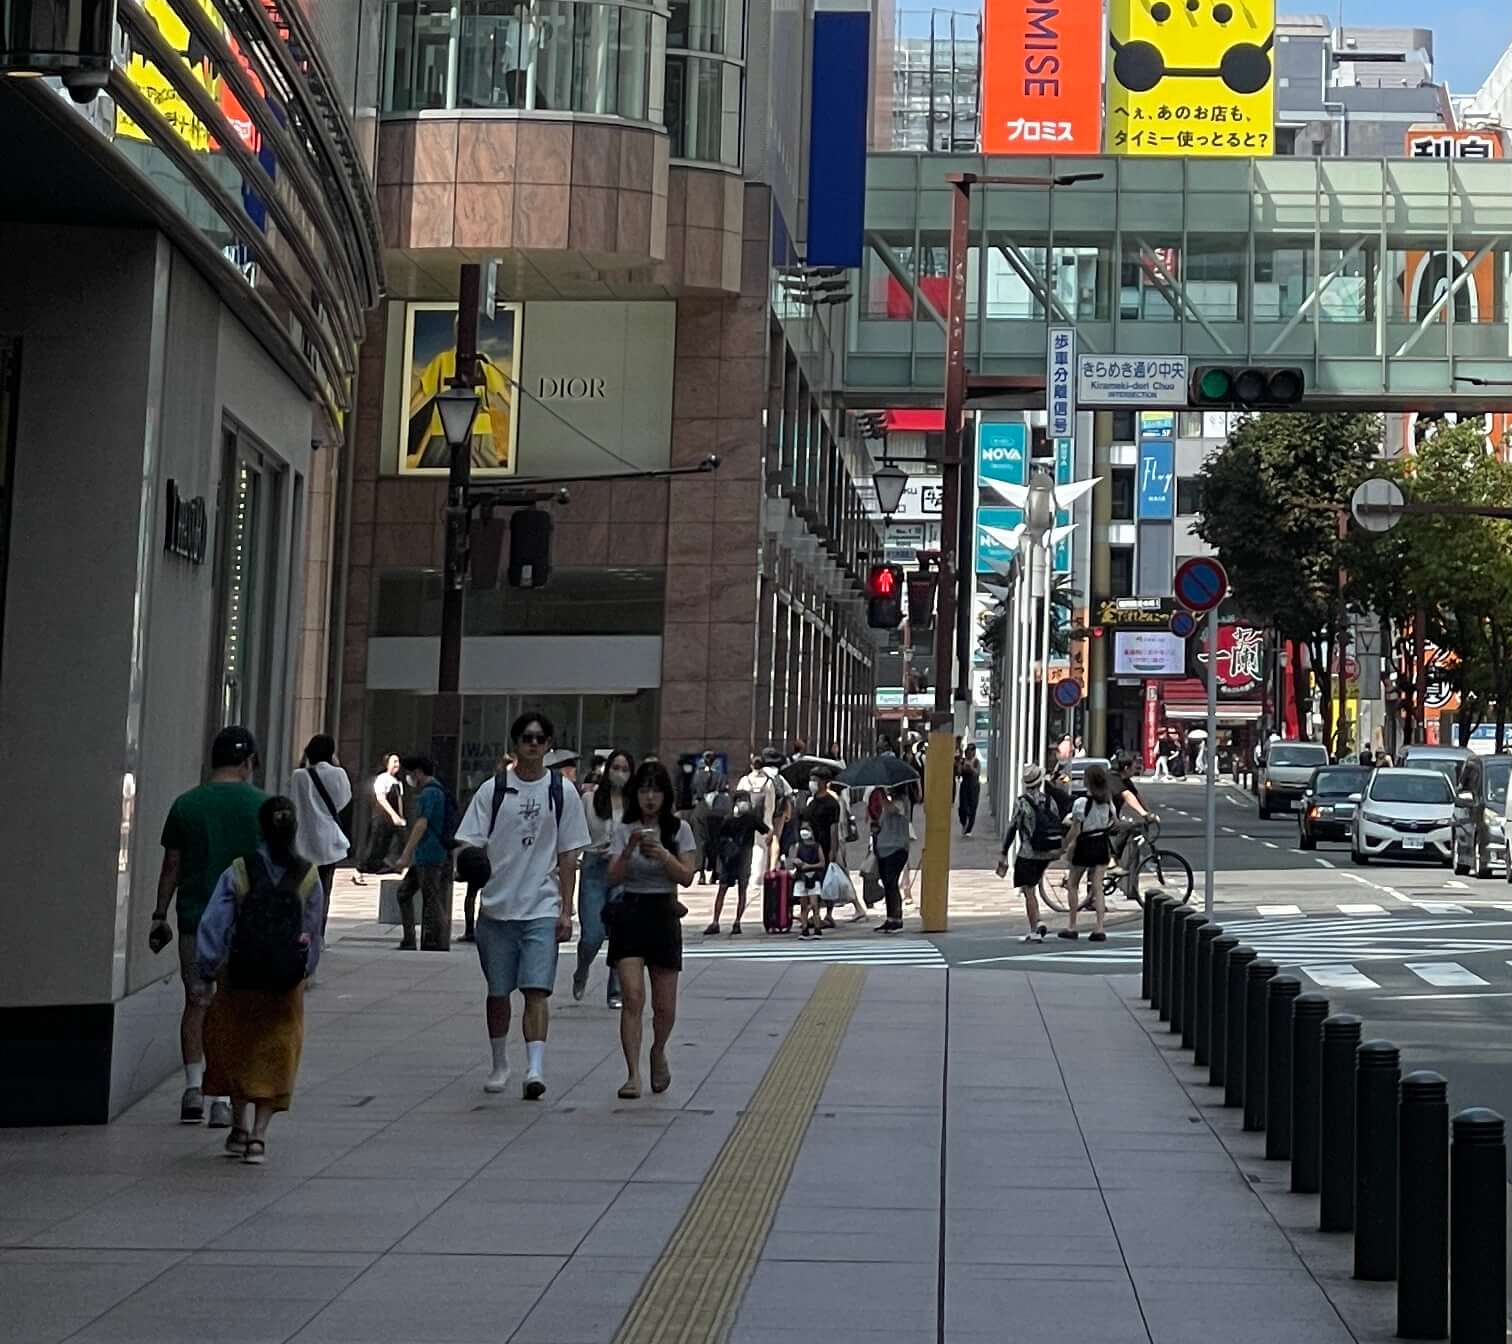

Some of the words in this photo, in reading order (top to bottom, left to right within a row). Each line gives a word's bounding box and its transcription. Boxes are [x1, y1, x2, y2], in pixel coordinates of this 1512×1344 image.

[1007, 117, 1074, 141] プロミス
[1083, 362, 1186, 379] きらめき通り中央
[538, 376, 608, 400] DIOR
[1053, 334, 1070, 434] 歩車分離信号
[1152, 381, 1175, 391] Chuo
[982, 448, 1022, 461] NOVA
[1197, 627, 1264, 682] 一蘭
